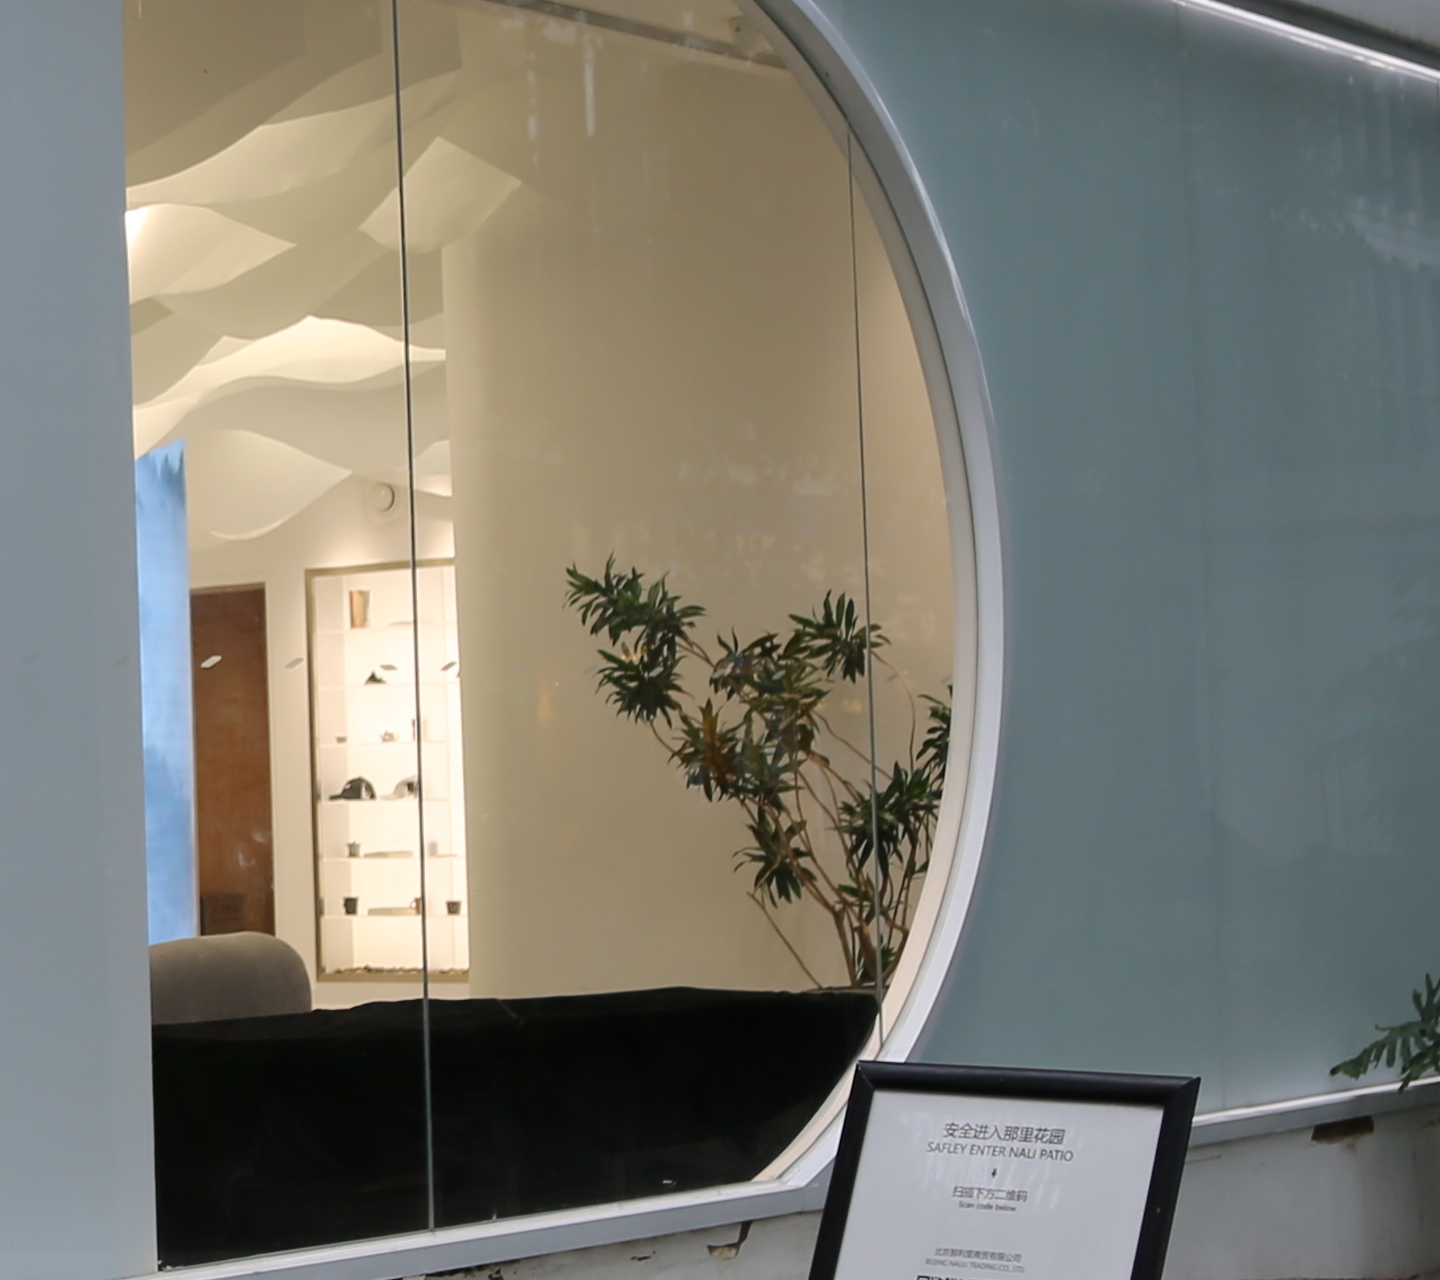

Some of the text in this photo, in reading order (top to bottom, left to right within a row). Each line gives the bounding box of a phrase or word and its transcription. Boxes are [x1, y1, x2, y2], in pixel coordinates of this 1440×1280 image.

[943, 1122, 1066, 1145] 安全进入那里花园
[926, 1141, 1074, 1162] SAFLEY ENTER NALI PATIO
[952, 1185, 1028, 1203] 扫描下方二维码
[958, 1201, 1017, 1212] Scan code below
